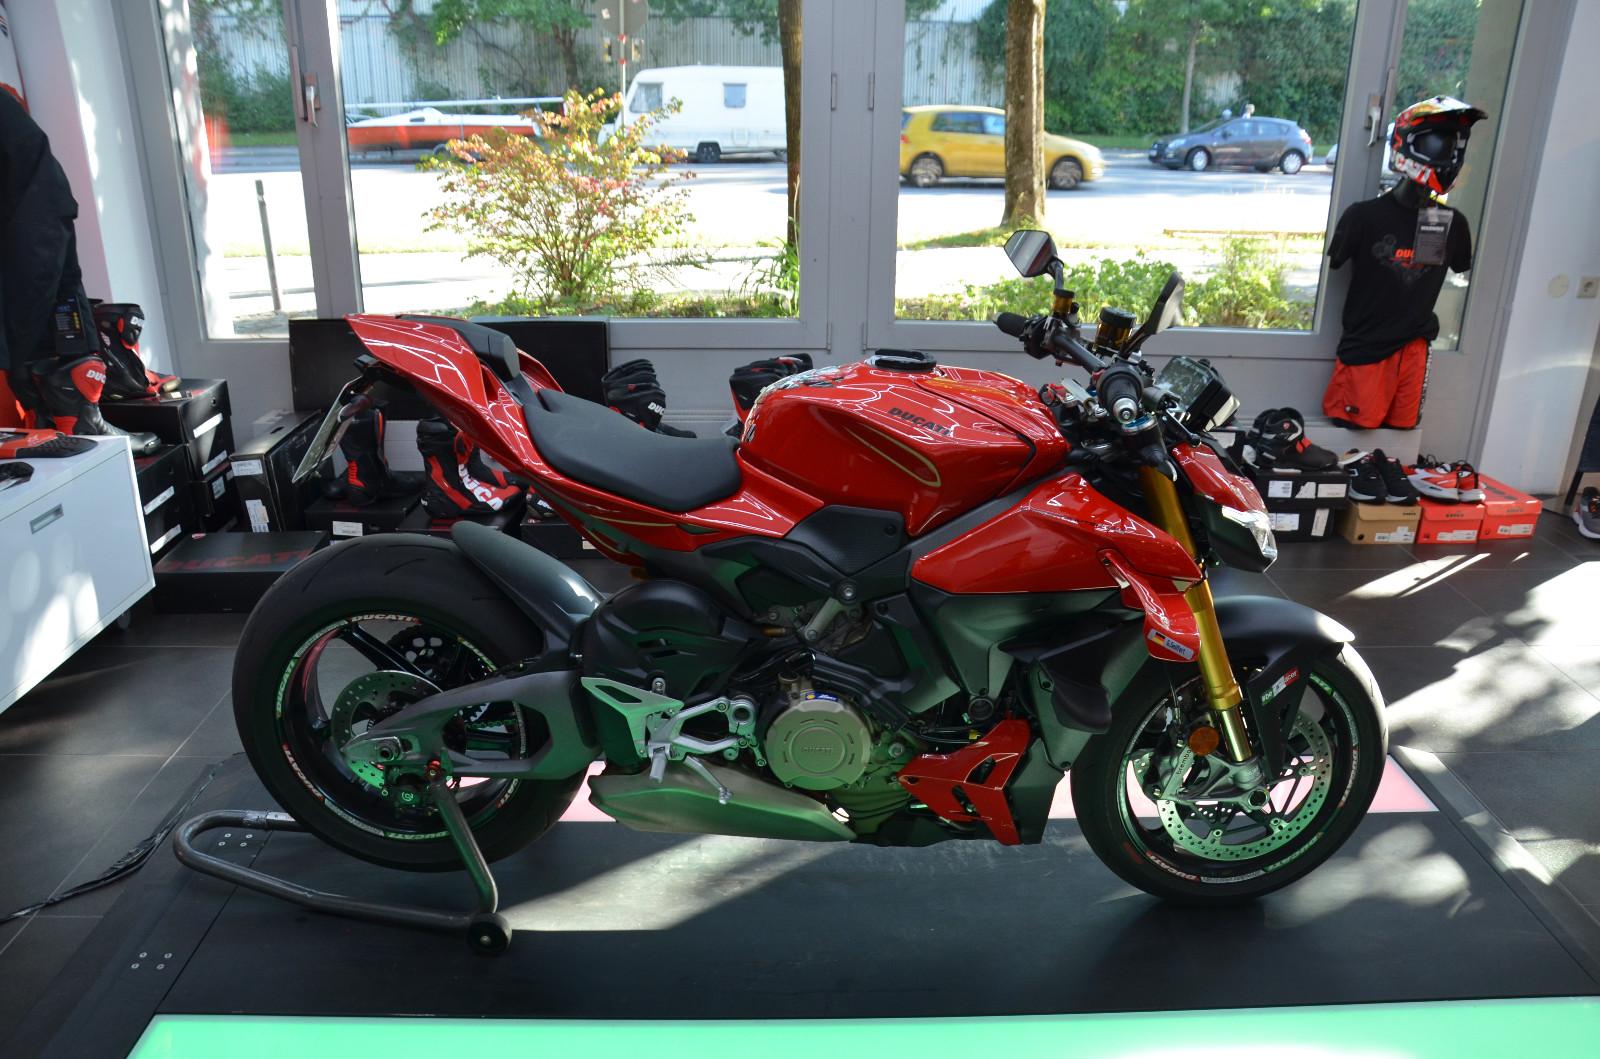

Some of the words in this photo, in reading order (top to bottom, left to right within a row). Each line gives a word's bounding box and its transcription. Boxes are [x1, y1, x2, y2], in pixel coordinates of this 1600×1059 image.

[888, 407, 951, 436] DUCATI
[352, 614, 414, 622] DUCATI
[1176, 749, 1191, 775] brembo
